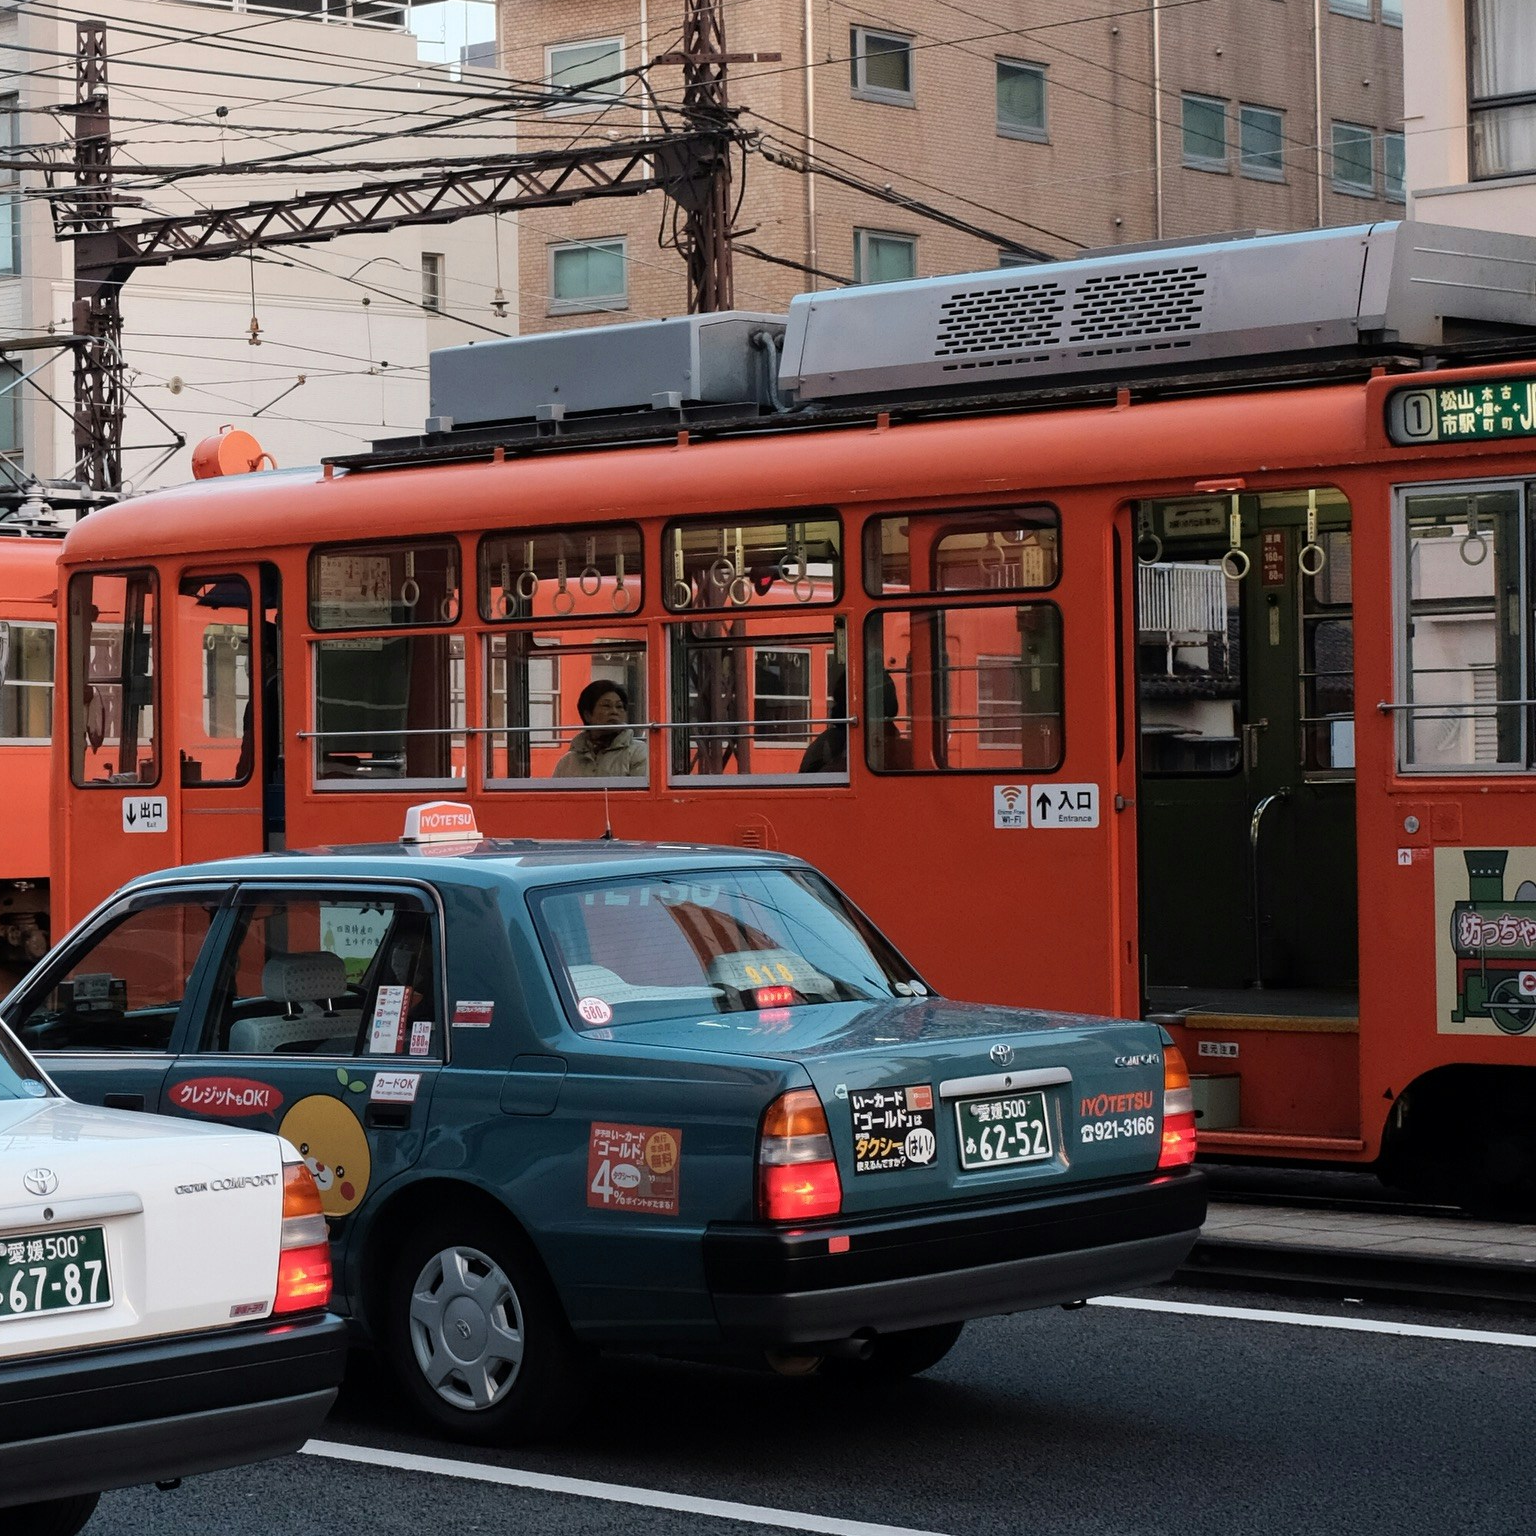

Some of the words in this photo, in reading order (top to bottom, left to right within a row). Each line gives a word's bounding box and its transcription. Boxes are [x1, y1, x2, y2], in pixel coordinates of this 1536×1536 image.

[1441, 389, 1474, 412] 松山
[1500, 385, 1513, 431] 古町
[1412, 400, 1422, 430] 1
[1441, 413, 1475, 435] 市駅
[140, 802, 162, 819] 出口
[1058, 790, 1091, 810] 入口
[421, 813, 472, 828] IYOTETSU
[1058, 814, 1092, 823] Entrance
[744, 963, 794, 984] 918
[376, 1078, 415, 1090] カードOK
[180, 1084, 270, 1107] クレジットもOK!
[1081, 1090, 1153, 1117] IYOTETSU
[1095, 1116, 1155, 1141] 921-3166
[966, 1137, 977, 1154] あ
[980, 1119, 1046, 1161] 62-52
[210, 1173, 279, 1192] COMFORT
[9, 1260, 102, 1313] 67-87
